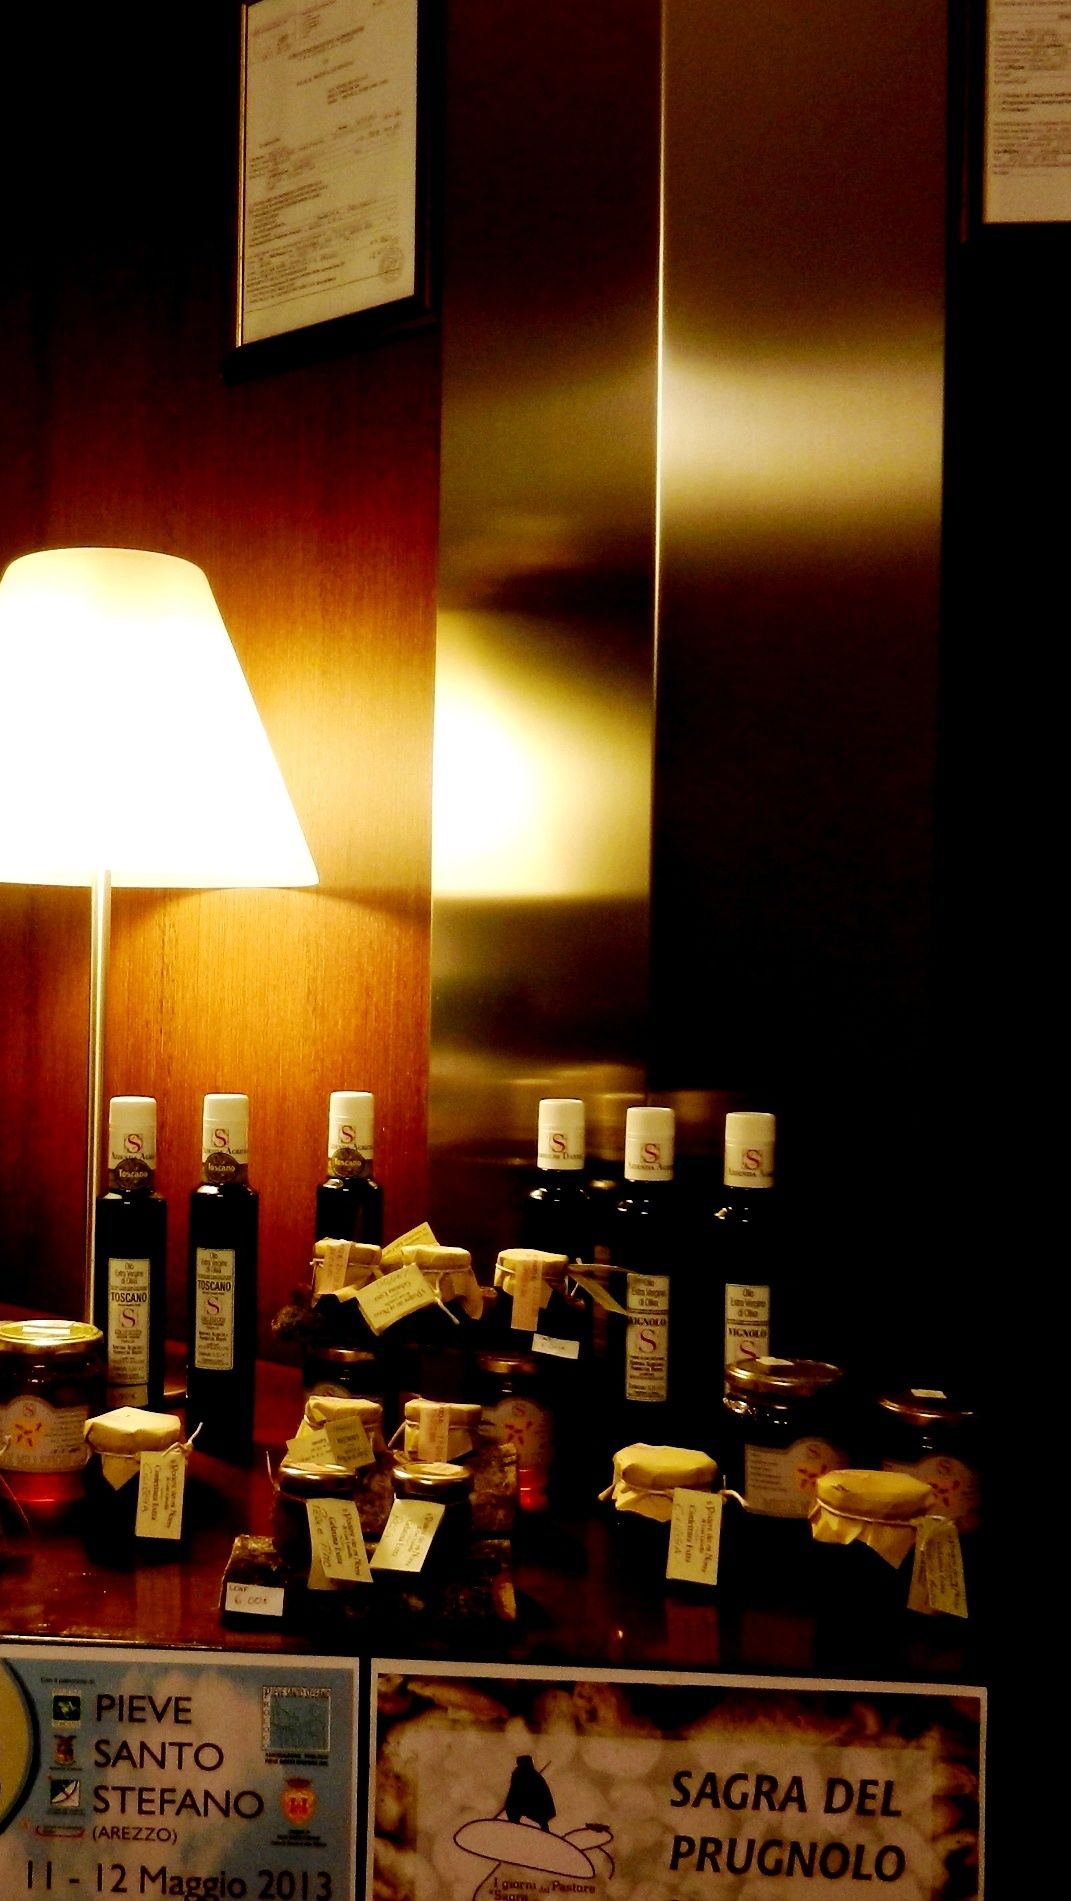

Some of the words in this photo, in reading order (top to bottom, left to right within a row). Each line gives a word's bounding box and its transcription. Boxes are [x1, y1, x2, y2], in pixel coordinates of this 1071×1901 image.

[118, 1168, 150, 1179] Toscano
[208, 1162, 236, 1172] Toscano
[197, 1280, 232, 1292] TOSCANO
[111, 1291, 147, 1302] TOSCANO
[206, 1296, 220, 1316] S
[121, 1307, 136, 1328] S
[627, 1317, 667, 1326] VIGNOLO
[638, 1328, 657, 1353] S
[727, 1327, 767, 1338] VIGNOLO
[96, 1693, 192, 1725] PIEVE
[94, 1739, 224, 1772] SANTO
[93, 1785, 265, 1819] STEFANO
[670, 1770, 808, 1813] SAGRA
[823, 1777, 904, 1818] DEL
[92, 1826, 178, 1845] (AREZZO)
[669, 1834, 906, 1883] PRUGNOLO
[26, 1860, 52, 1890] 11
[97, 1863, 128, 1893] 12
[139, 1865, 246, 1901] Maggio
[258, 1869, 333, 1900] 2013
[494, 1877, 498, 1888] I
[501, 1879, 536, 1891] giorni
[552, 1880, 596, 1894] Pastore
